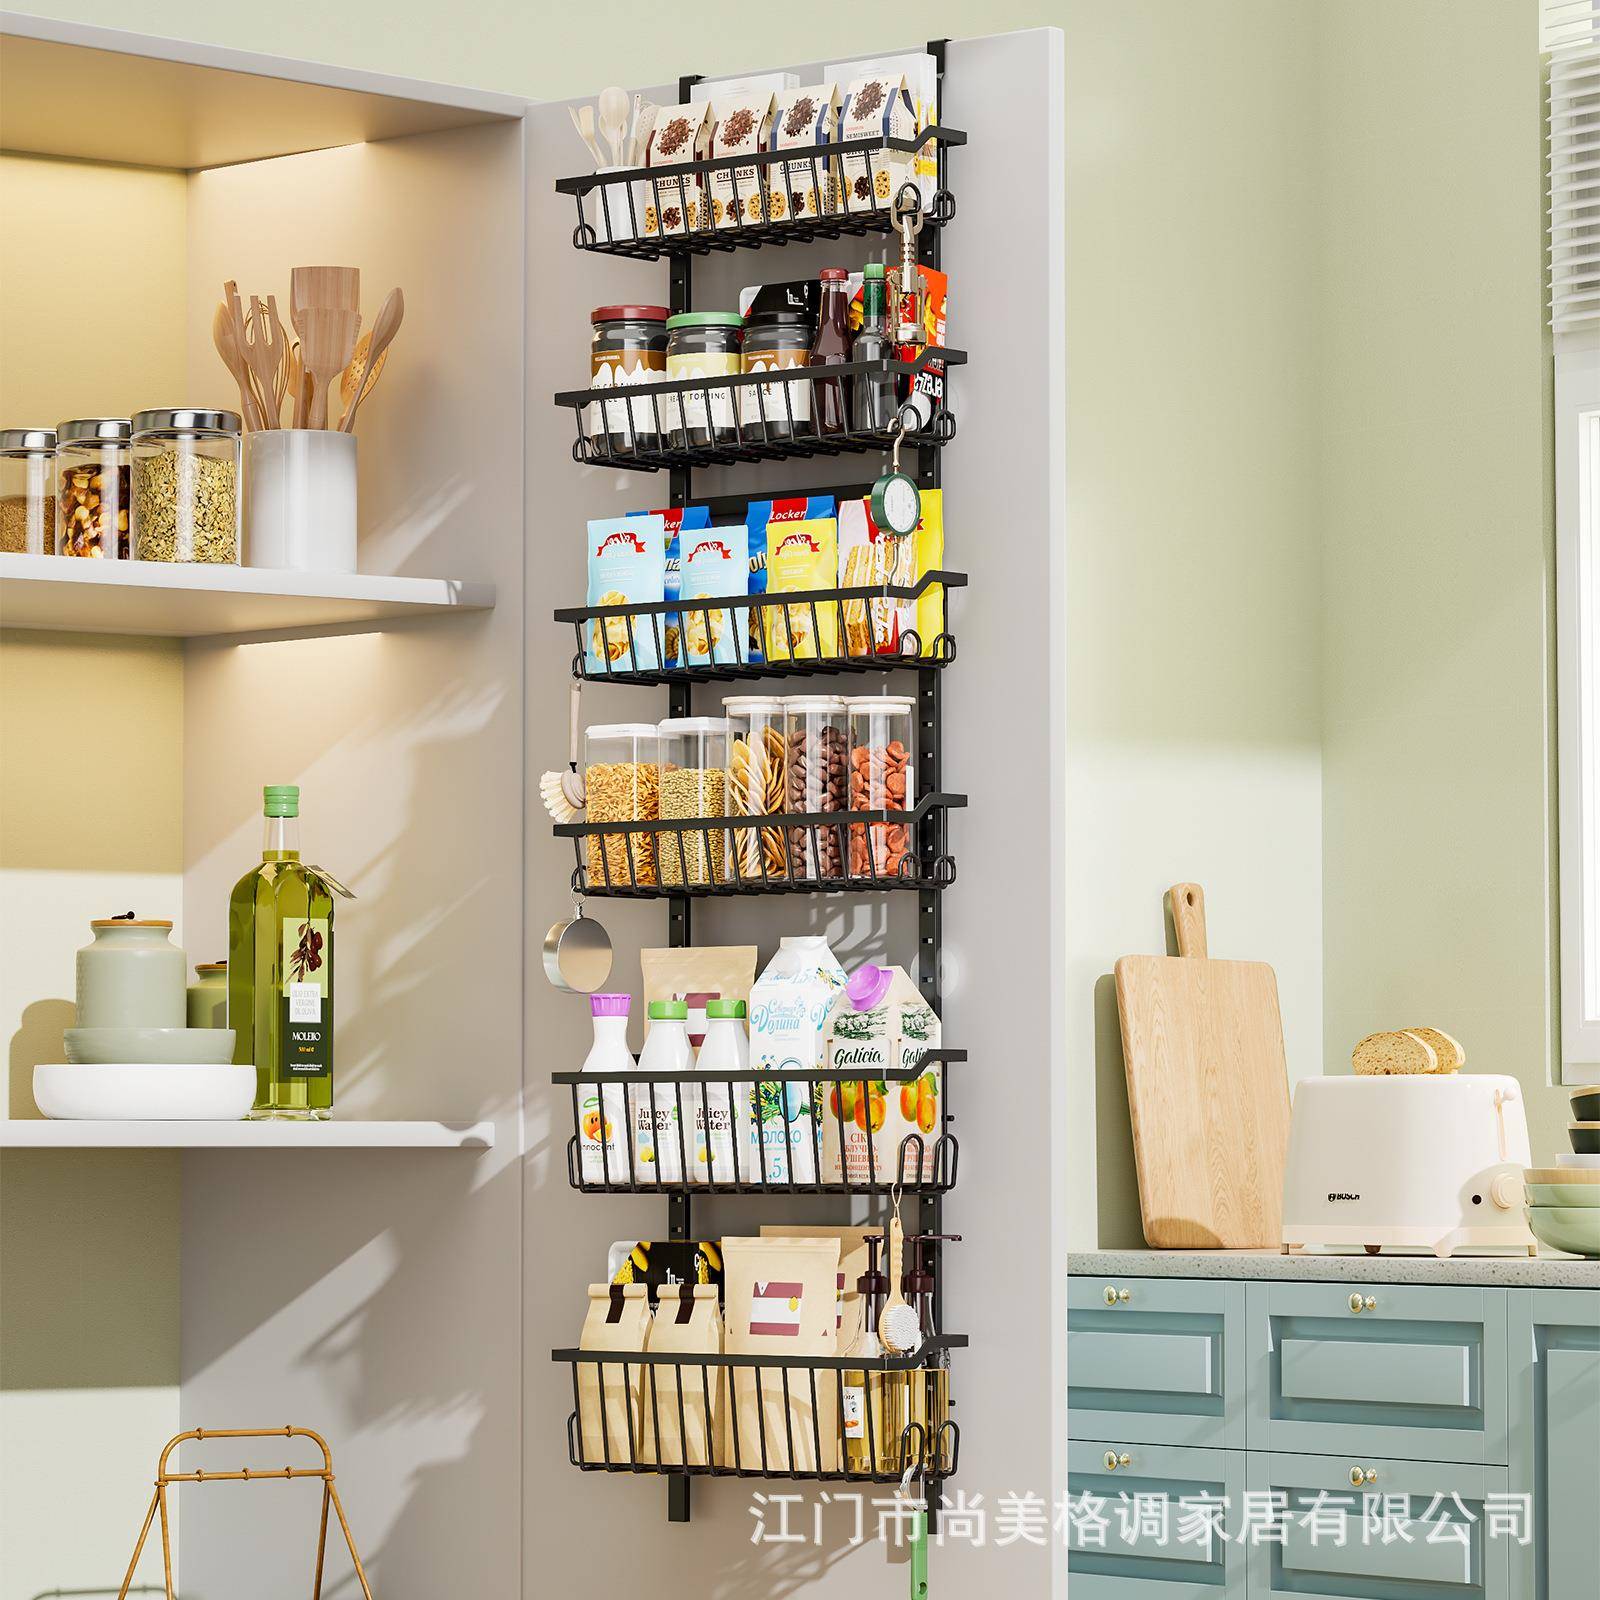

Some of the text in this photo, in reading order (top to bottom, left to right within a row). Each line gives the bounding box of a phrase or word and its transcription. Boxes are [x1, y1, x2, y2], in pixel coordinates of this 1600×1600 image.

[716, 168, 755, 181] CHNKS
[689, 392, 725, 401] TOPING
[748, 389, 772, 397] SACE
[638, 1108, 670, 1120] Jucy
[696, 1107, 729, 1120] Jicy
[638, 1119, 672, 1131] Waer
[696, 1118, 731, 1131] Wter
